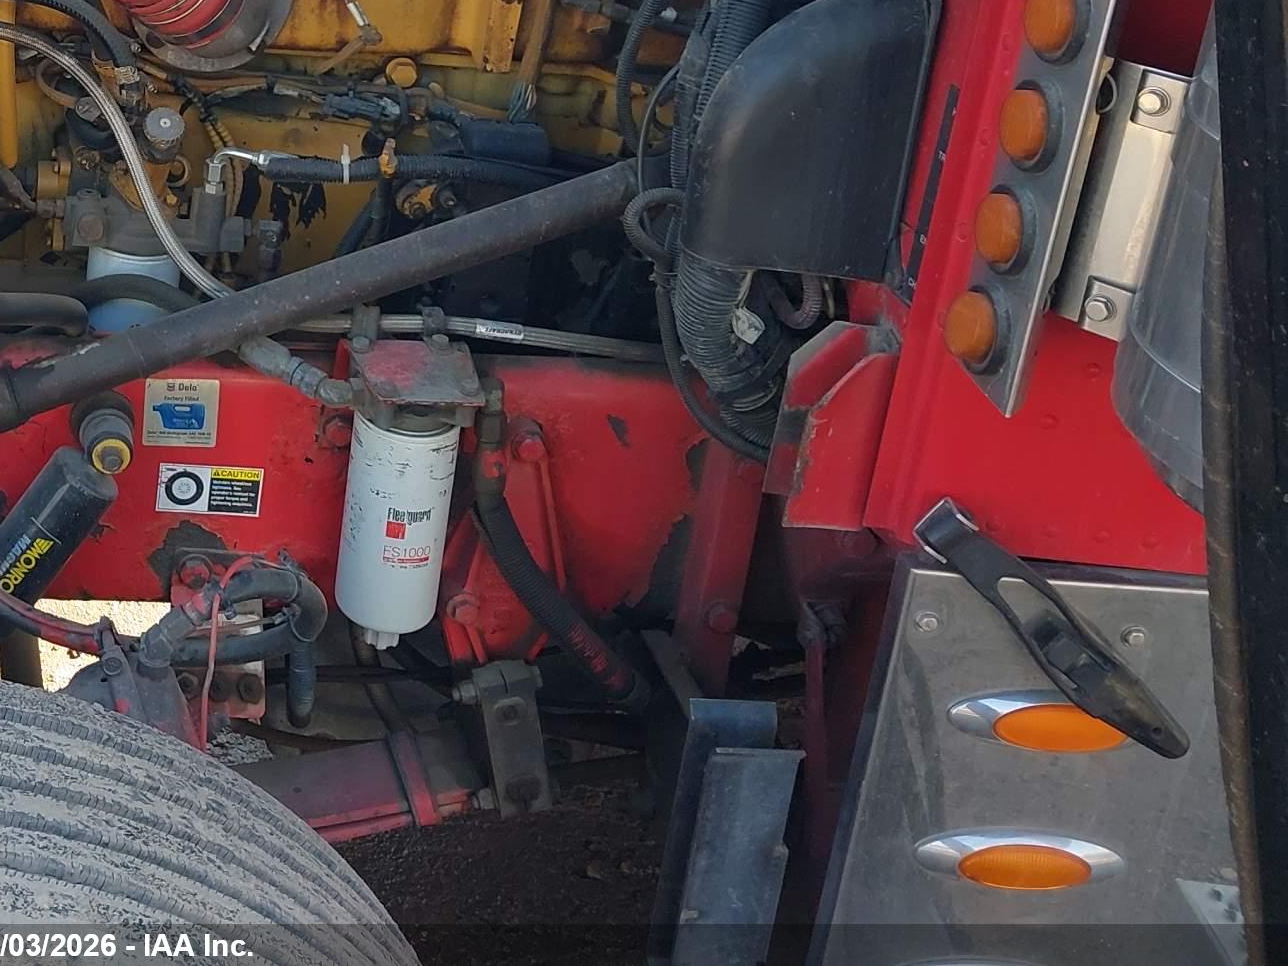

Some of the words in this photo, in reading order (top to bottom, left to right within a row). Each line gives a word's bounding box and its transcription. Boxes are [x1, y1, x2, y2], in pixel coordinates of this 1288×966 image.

[178, 382, 198, 392] Delo
[221, 470, 259, 479] CAUTION
[387, 507, 432, 526] Fleeguard
[383, 545, 431, 558] FS1000
